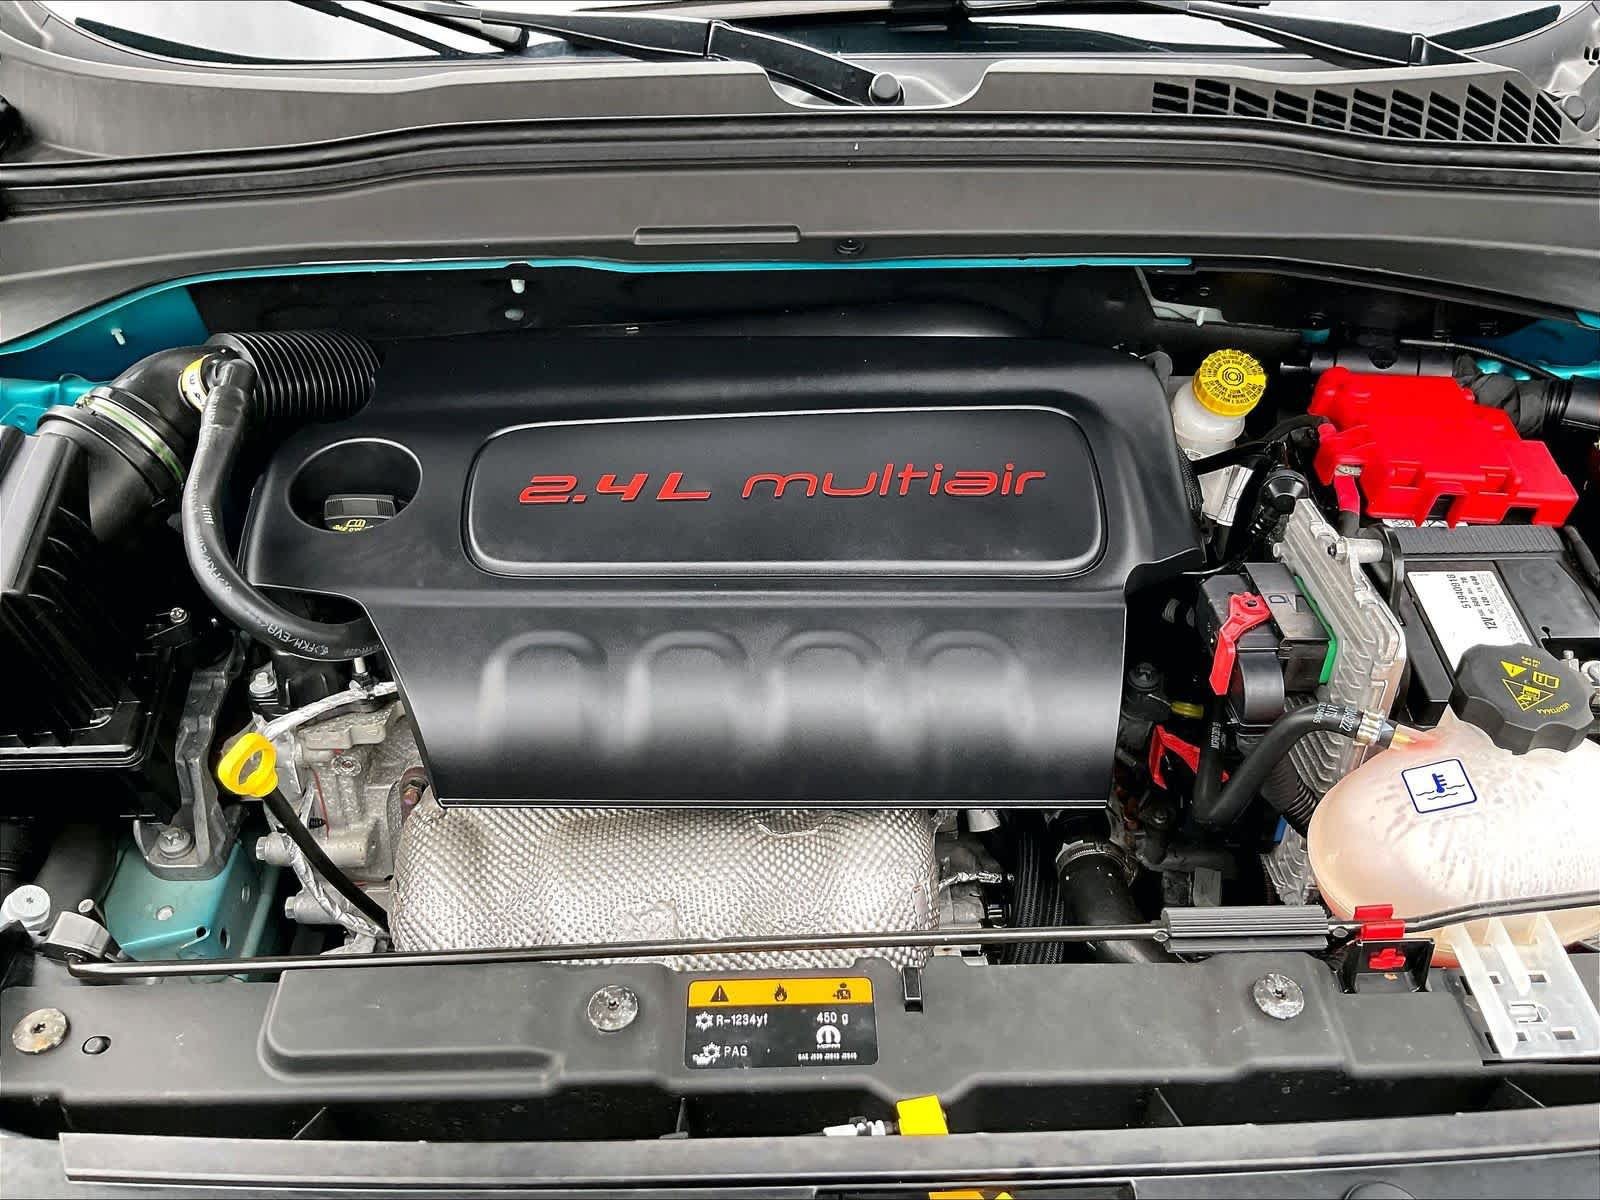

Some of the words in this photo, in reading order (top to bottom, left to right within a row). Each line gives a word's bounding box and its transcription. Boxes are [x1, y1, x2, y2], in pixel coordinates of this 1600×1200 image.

[741, 463, 1046, 498] multiair
[1480, 616, 1498, 629] 12V
[716, 1012, 768, 1027] R-1234yf
[723, 1045, 748, 1058] PAG
